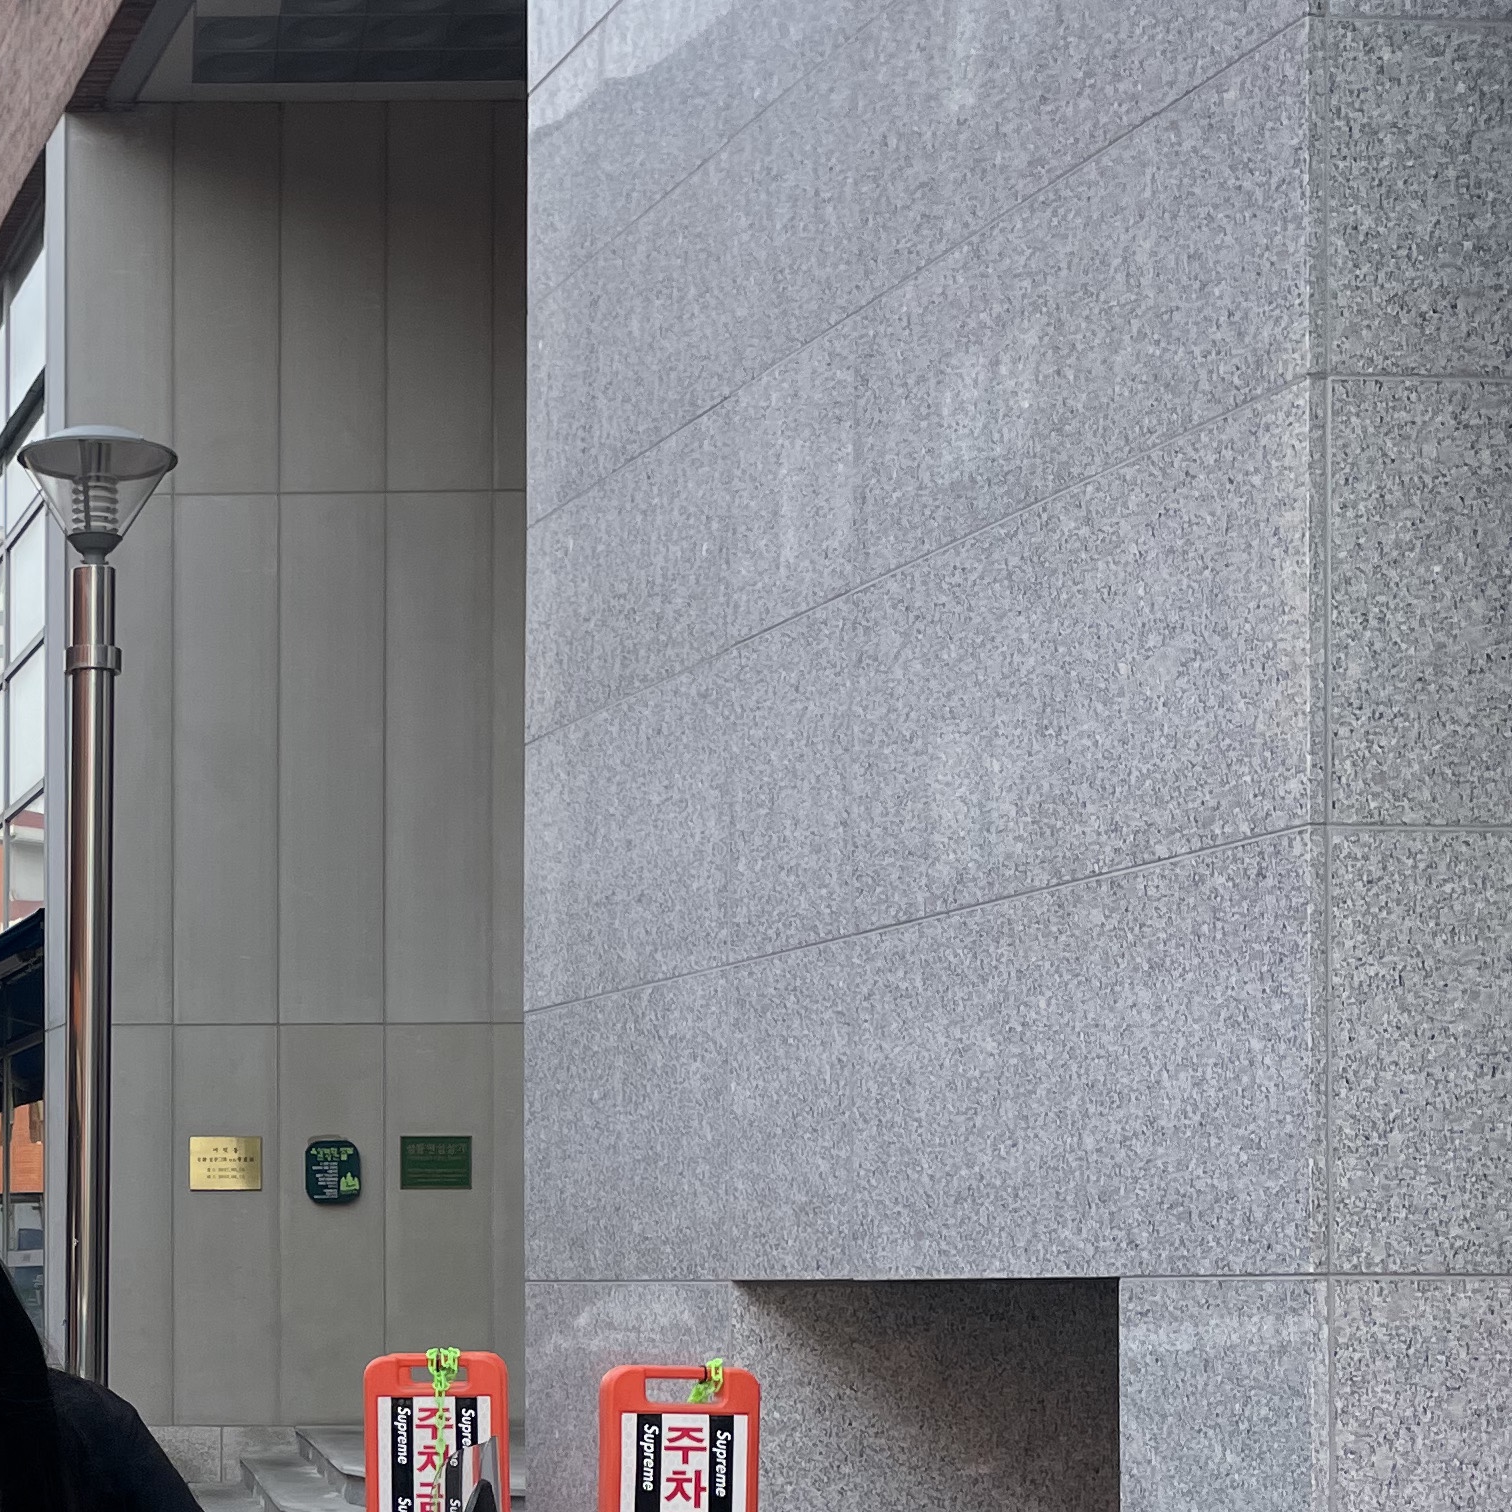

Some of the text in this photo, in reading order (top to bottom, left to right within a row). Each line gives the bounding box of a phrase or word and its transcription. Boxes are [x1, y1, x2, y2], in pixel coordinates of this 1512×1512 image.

[393, 1406, 412, 1465] Supreme
[639, 1423, 660, 1492] Supreme
[711, 1429, 732, 1498] Supreme
